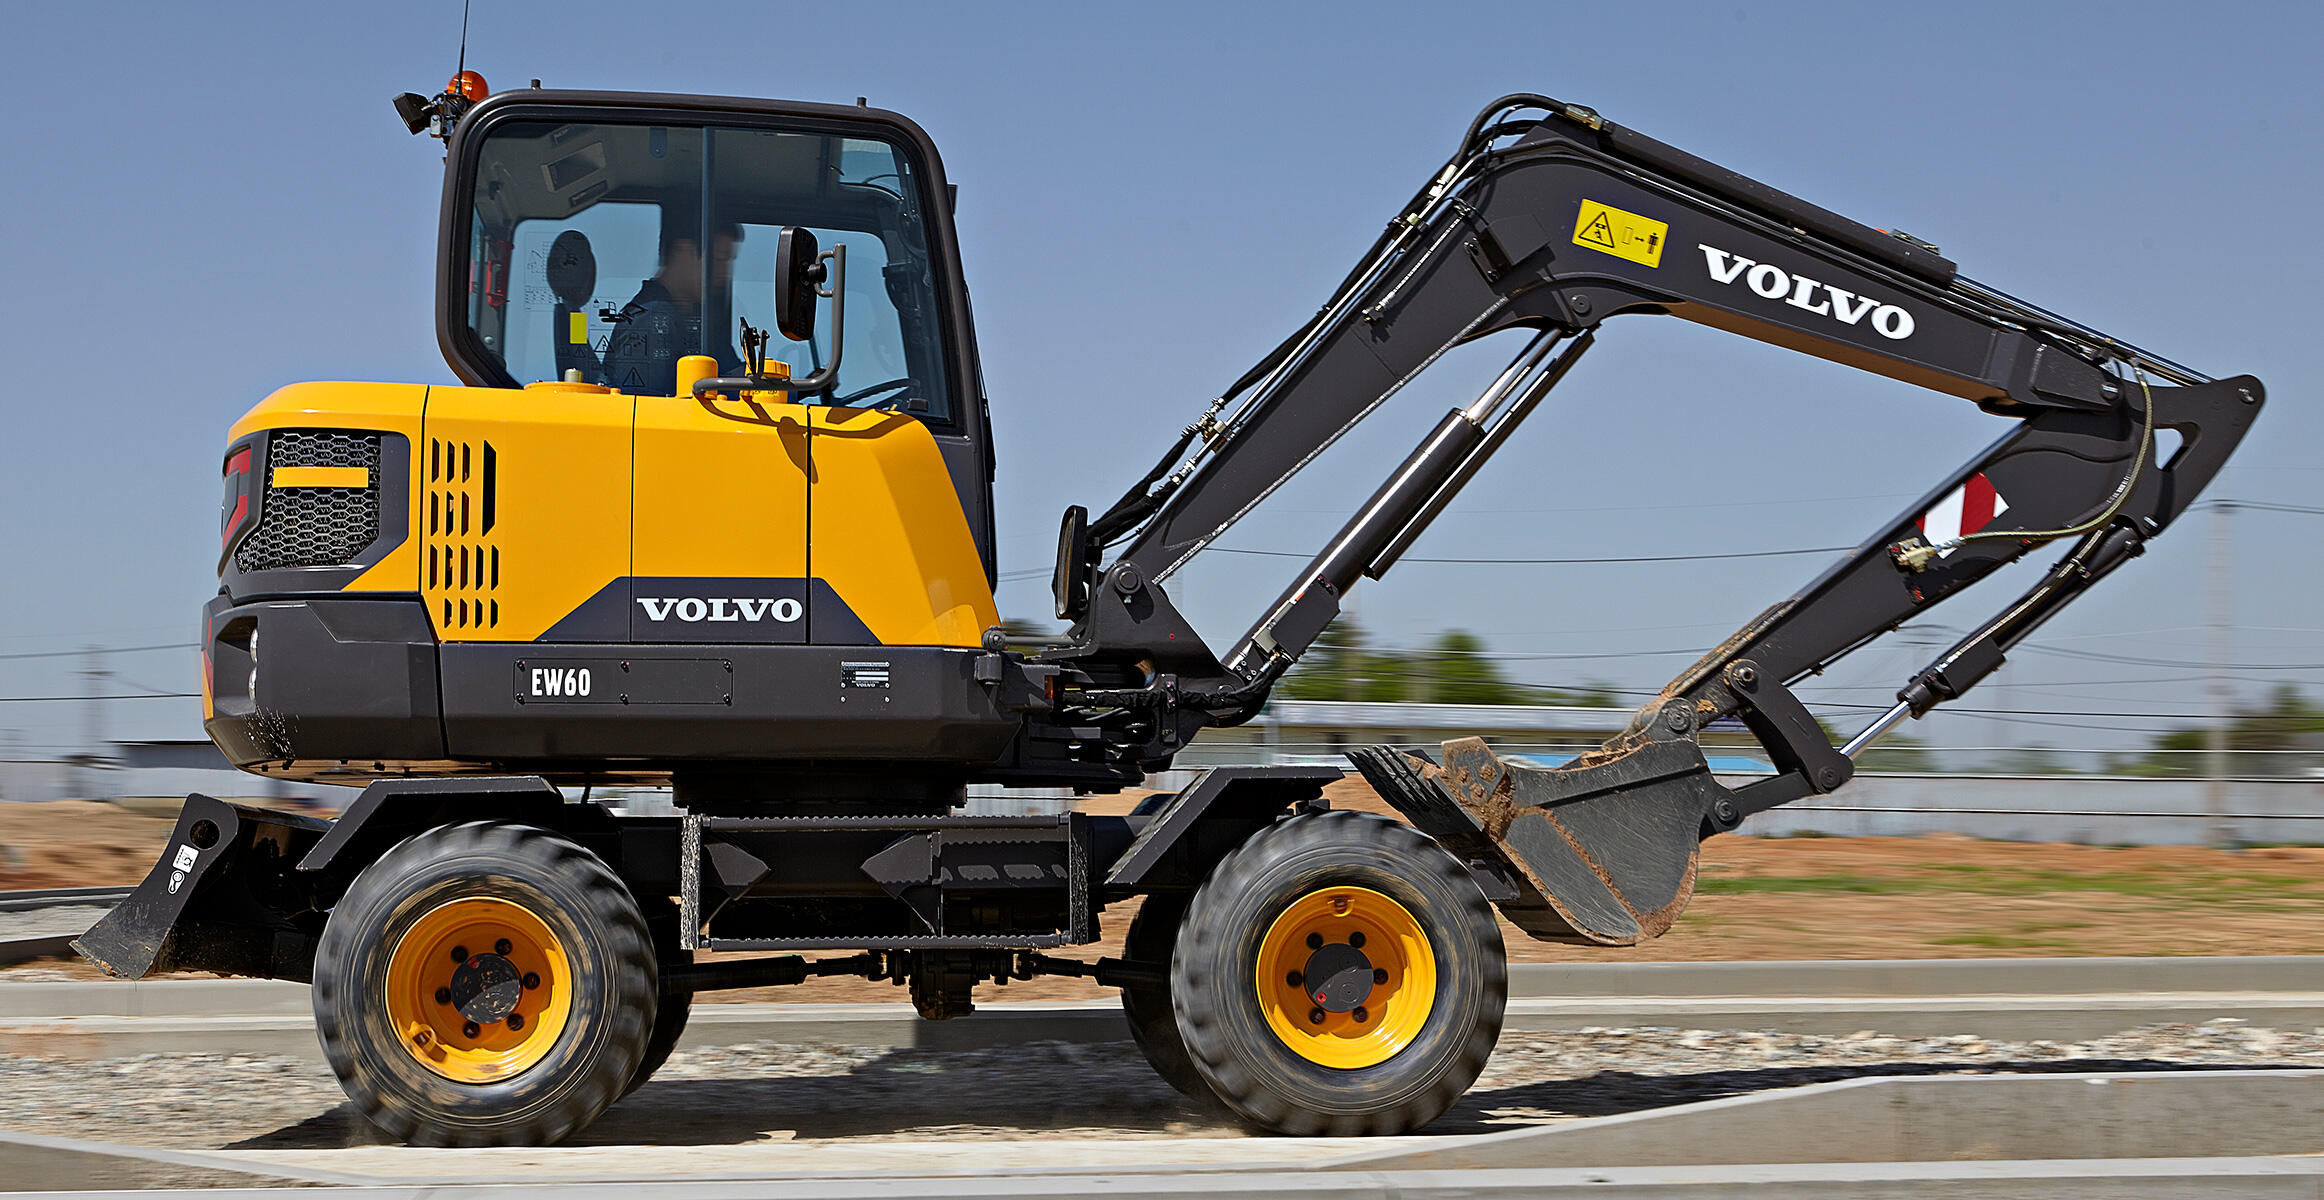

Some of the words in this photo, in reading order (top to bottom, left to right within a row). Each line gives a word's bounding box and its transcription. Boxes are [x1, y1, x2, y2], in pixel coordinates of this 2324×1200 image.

[1698, 243, 1916, 340] VOLVO
[636, 597, 803, 623] VOLVO
[531, 668, 591, 697] EW60
